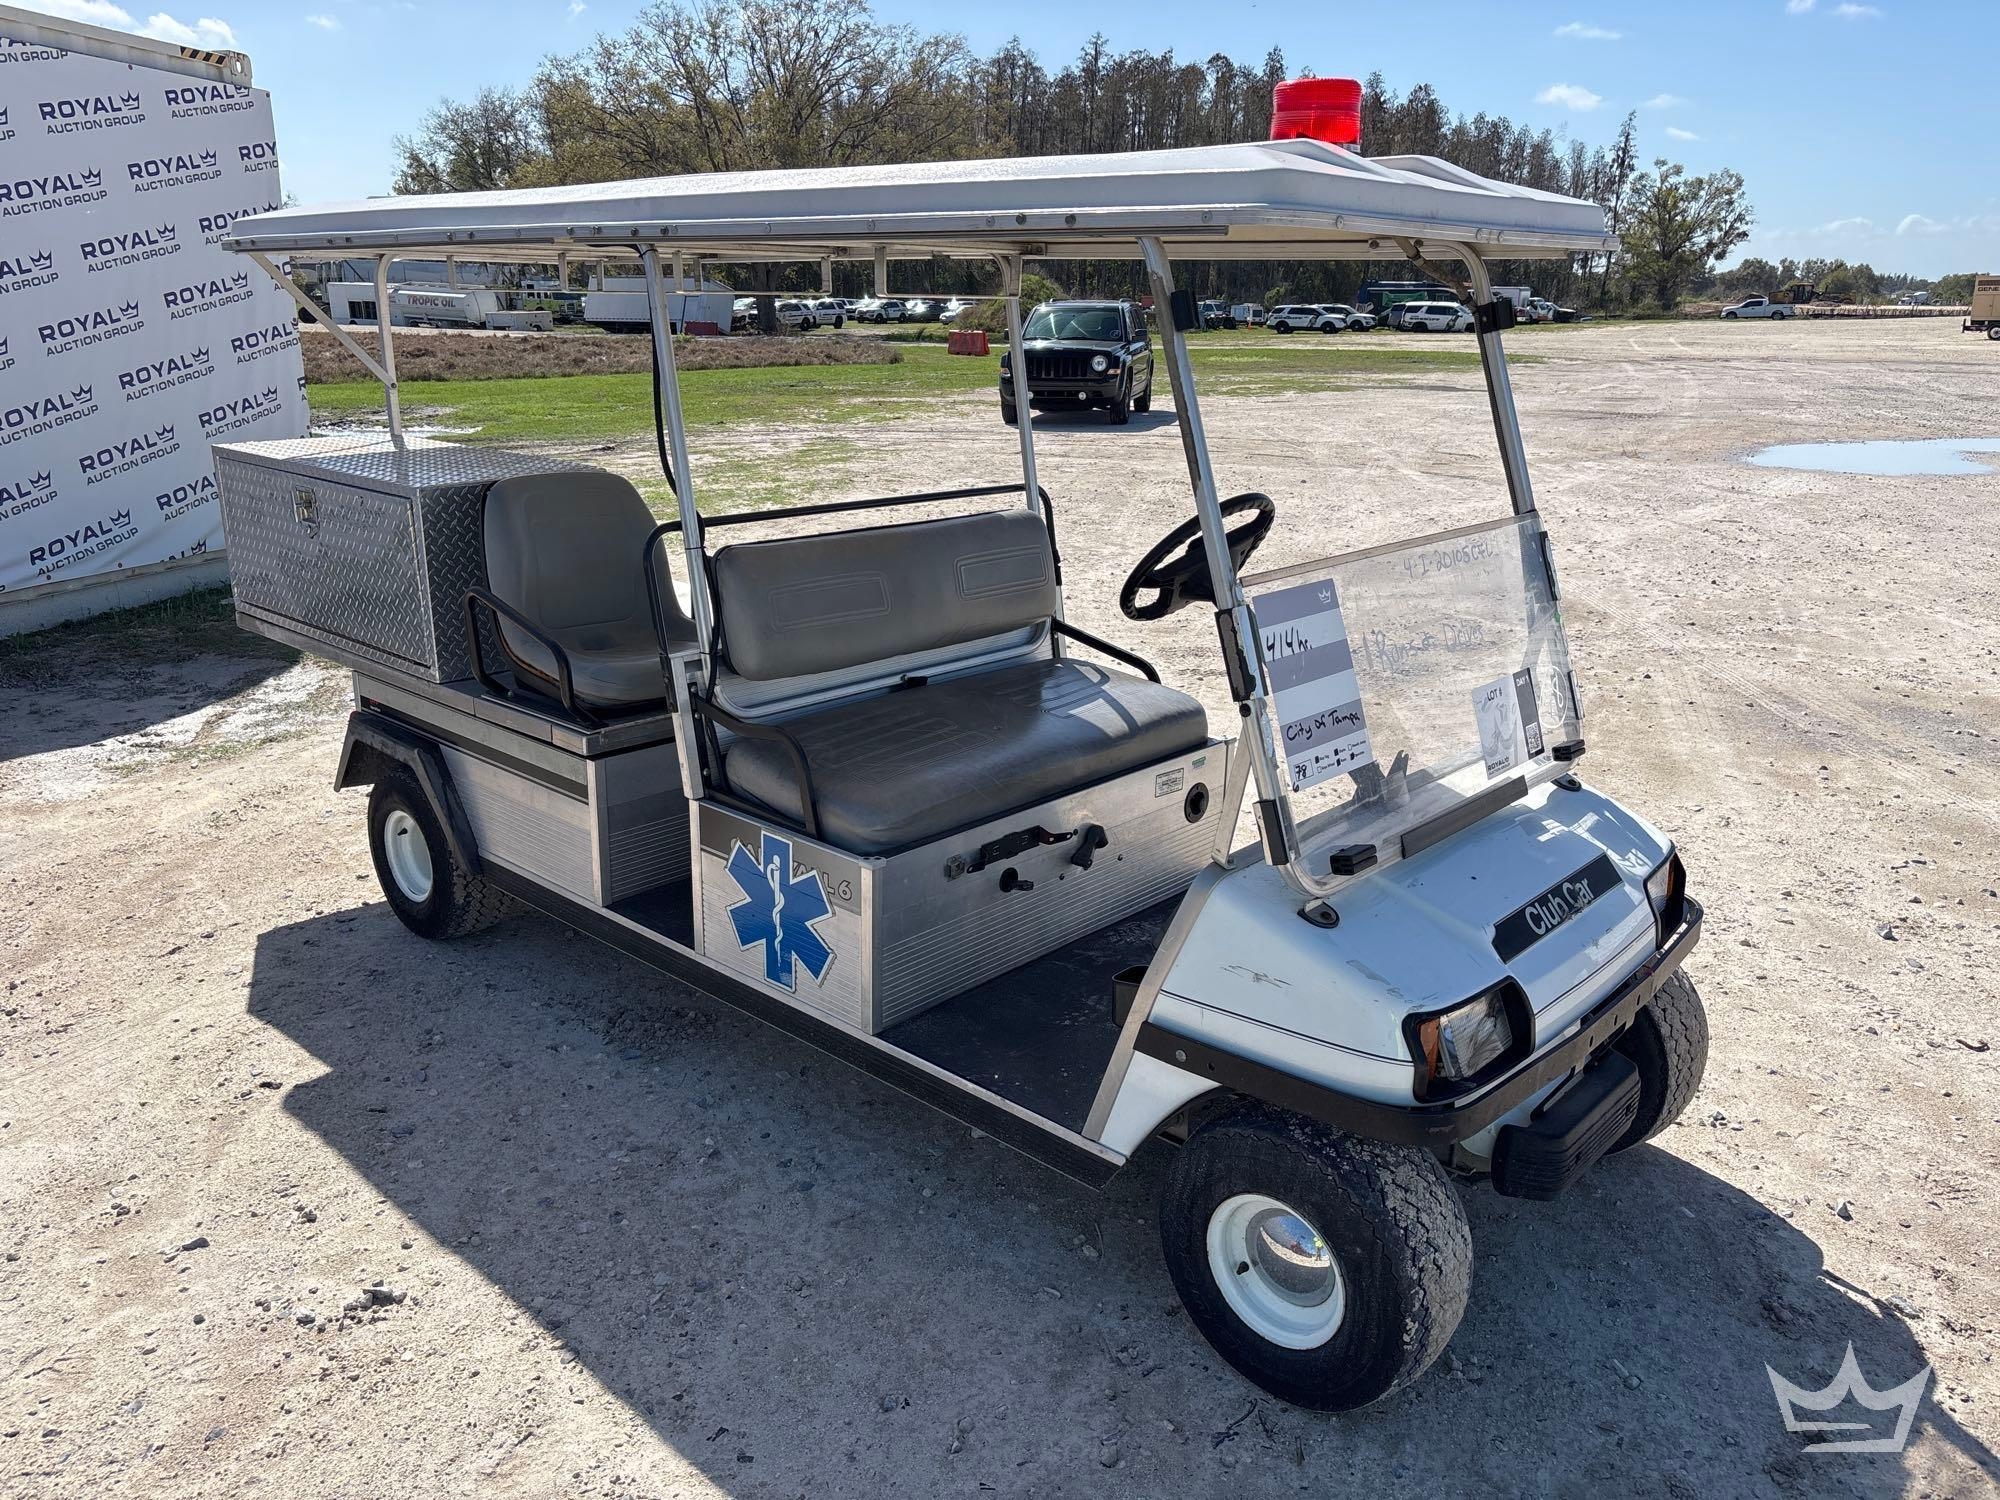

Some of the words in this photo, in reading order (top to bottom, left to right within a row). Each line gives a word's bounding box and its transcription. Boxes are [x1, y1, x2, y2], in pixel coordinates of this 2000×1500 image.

[21, 50, 68, 61] GROUP
[38, 96, 122, 121] ROYAL
[165, 84, 235, 106] ROYAL
[171, 105, 218, 119] AUCTION
[219, 101, 254, 113] GROUP
[47, 119, 103, 135] AUCTION
[104, 113, 146, 127] GROUP
[238, 142, 278, 161] ROY
[244, 160, 279, 173] AUCTIO
[127, 154, 202, 180] ROYAL
[134, 177, 184, 193] AUCTION
[185, 169, 222, 184] GROUP
[0, 174, 83, 203] ROYAL
[2, 199, 63, 217] AUCTION
[64, 189, 108, 206] GROUP
[80, 230, 159, 260] ROYAL
[205, 232, 232, 246] AUCT
[88, 253, 140, 273] AUCTION
[142, 243, 181, 260] GROUP
[12, 272, 59, 292] GROUP
[163, 278, 233, 309] ROYAL
[170, 301, 217, 321] AUCTION
[219, 290, 254, 307] GROUP
[407, 295, 439, 307] TROPIC
[441, 299, 456, 308] OIL
[38, 308, 121, 344] ROYAL
[46, 332, 102, 357] AUCTION
[103, 320, 145, 340] GROUP
[231, 323, 293, 353] ROYAL
[236, 344, 279, 365] AUCTION
[280, 337, 300, 350] GRO
[118, 355, 193, 390] ROYAL
[126, 378, 176, 402] AUCTION
[177, 365, 215, 385] GROUP
[0, 394, 74, 431] OYAL
[0, 419, 54, 446] UCTION
[54, 404, 99, 426] GROUP
[198, 394, 264, 428] ROYAL
[205, 416, 251, 440] AUCTION
[251, 403, 282, 422] GROUP
[79, 434, 158, 474] ROYAL
[86, 458, 139, 486] AUCTION
[140, 442, 181, 464] GROUP
[11, 490, 58, 516] GROUP
[156, 472, 216, 511] ROYA
[164, 496, 208, 522] AUCTION
[30, 520, 113, 566] ROYAL
[37, 547, 95, 577] AUCTION
[96, 527, 139, 552] GROUP
[1487, 689, 1498, 702] LOT
[1286, 723, 1313, 741] City
[1328, 709, 1361, 727] Tampa
[1487, 759, 1505, 772] ROYAL
[1525, 893, 1569, 935] Club
[1562, 877, 1595, 909] Car
